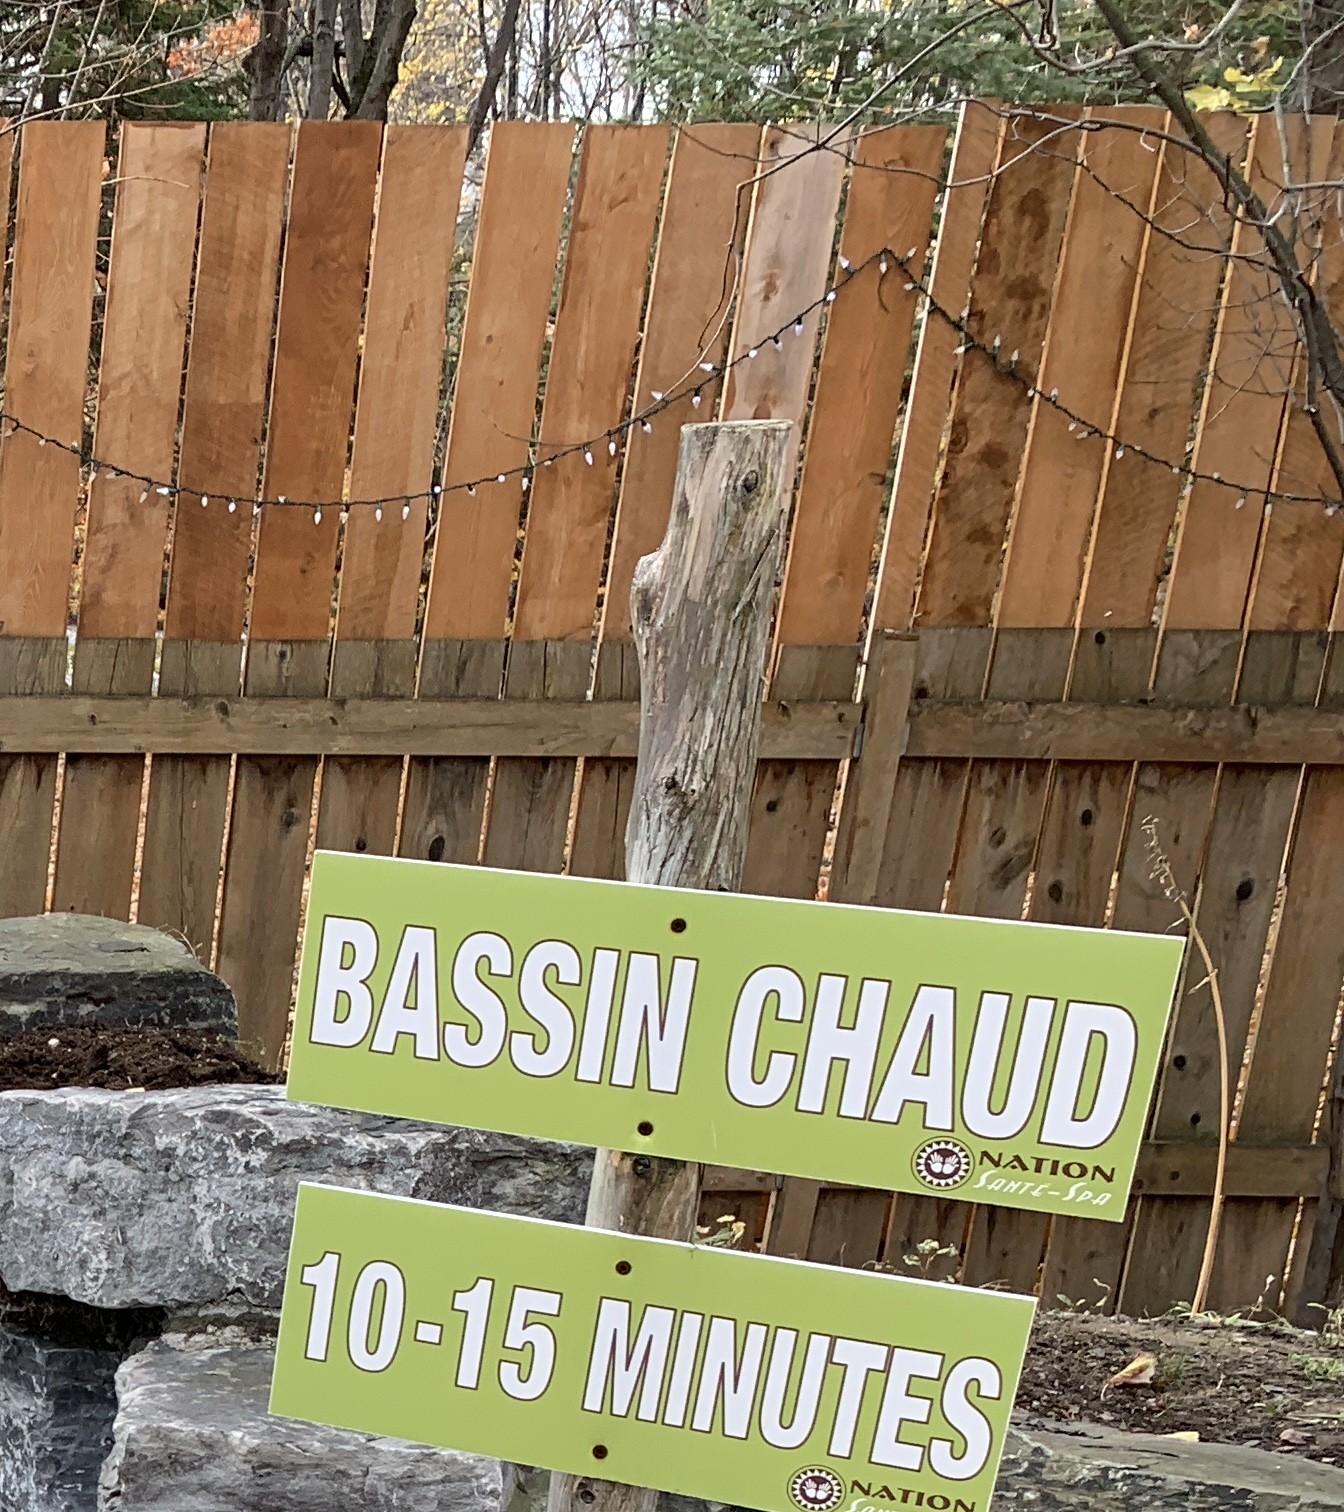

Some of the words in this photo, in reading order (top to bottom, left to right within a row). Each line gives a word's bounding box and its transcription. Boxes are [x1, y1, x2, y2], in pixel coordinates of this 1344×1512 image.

[309, 915, 699, 1094] BASSIN
[726, 965, 1139, 1149] CHAUD
[979, 1150, 1115, 1183] NATION
[300, 1251, 564, 1401] 10-15
[581, 1297, 1001, 1480] MINUTES
